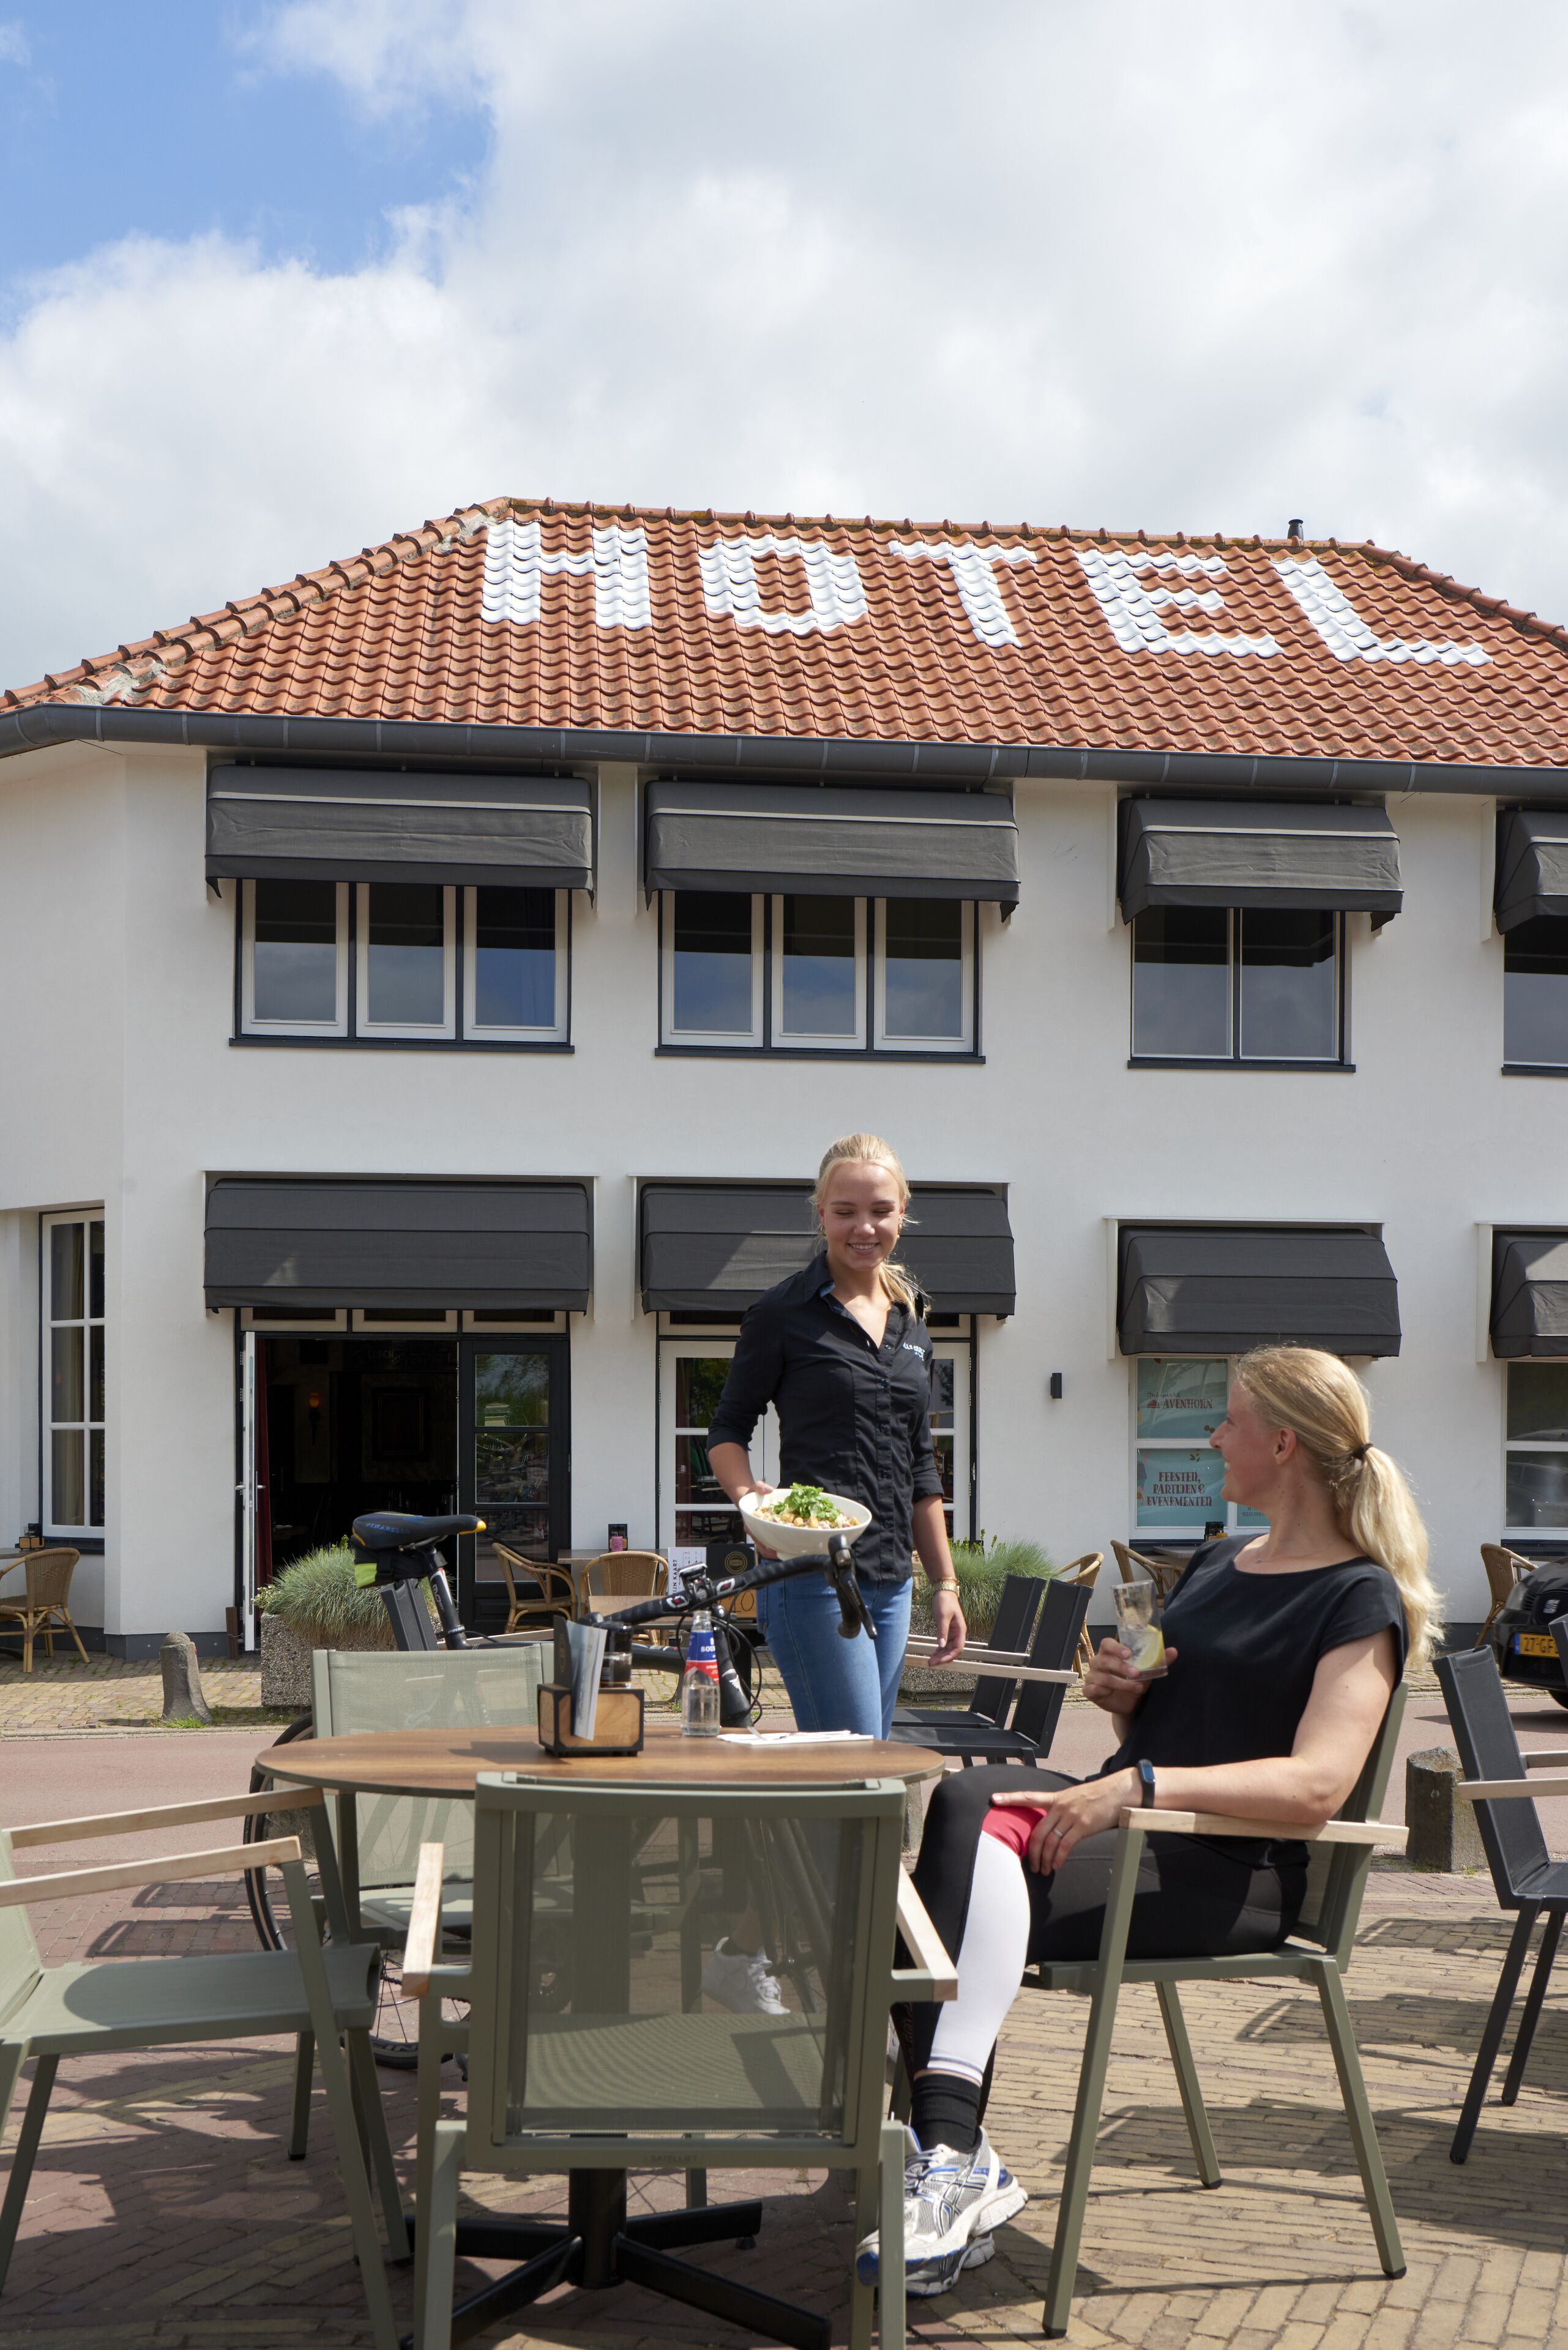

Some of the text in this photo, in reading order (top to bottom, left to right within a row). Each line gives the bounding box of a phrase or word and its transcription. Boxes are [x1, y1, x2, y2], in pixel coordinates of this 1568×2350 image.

[482, 519, 1494, 666] HOTEL
[1163, 1399, 1212, 1409] AVENHORN
[1159, 1472, 1200, 1483] FEESTEN,
[1153, 1483, 1197, 1494] PARTIJEN
[1146, 1496, 1212, 1507] EVENEMENTEN
